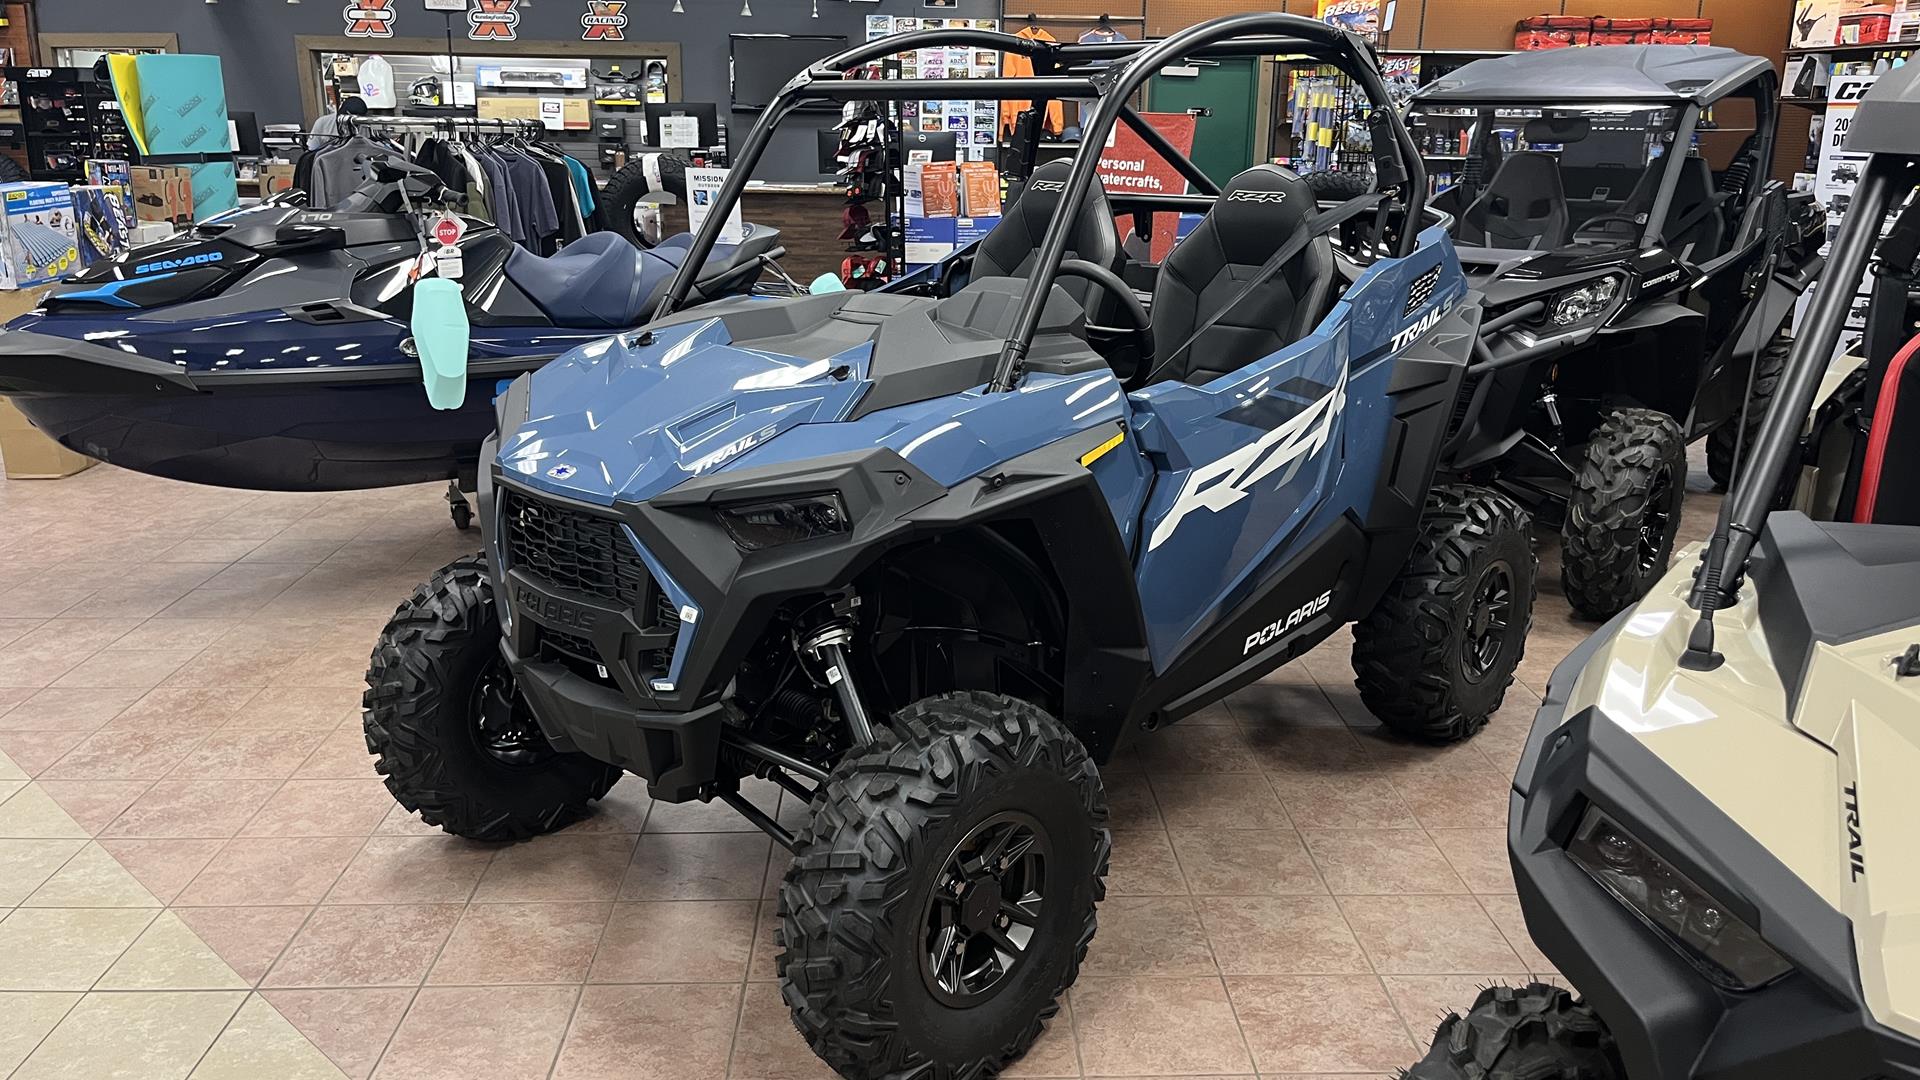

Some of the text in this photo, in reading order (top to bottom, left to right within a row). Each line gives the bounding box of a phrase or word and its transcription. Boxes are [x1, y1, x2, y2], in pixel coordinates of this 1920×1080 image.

[586, 16, 623, 24] RACING
[693, 175, 724, 183] MISSION
[1227, 189, 1287, 203] RZR
[104, 192, 131, 250] BEAST
[300, 213, 333, 222] 170
[439, 229, 456, 237] STOP
[1391, 305, 1442, 354] TRAIL
[690, 436, 758, 476] TRAIL
[516, 586, 596, 632] POLARIS
[1243, 589, 1332, 655] POLARIS
[1843, 780, 1865, 883] TRAIL
